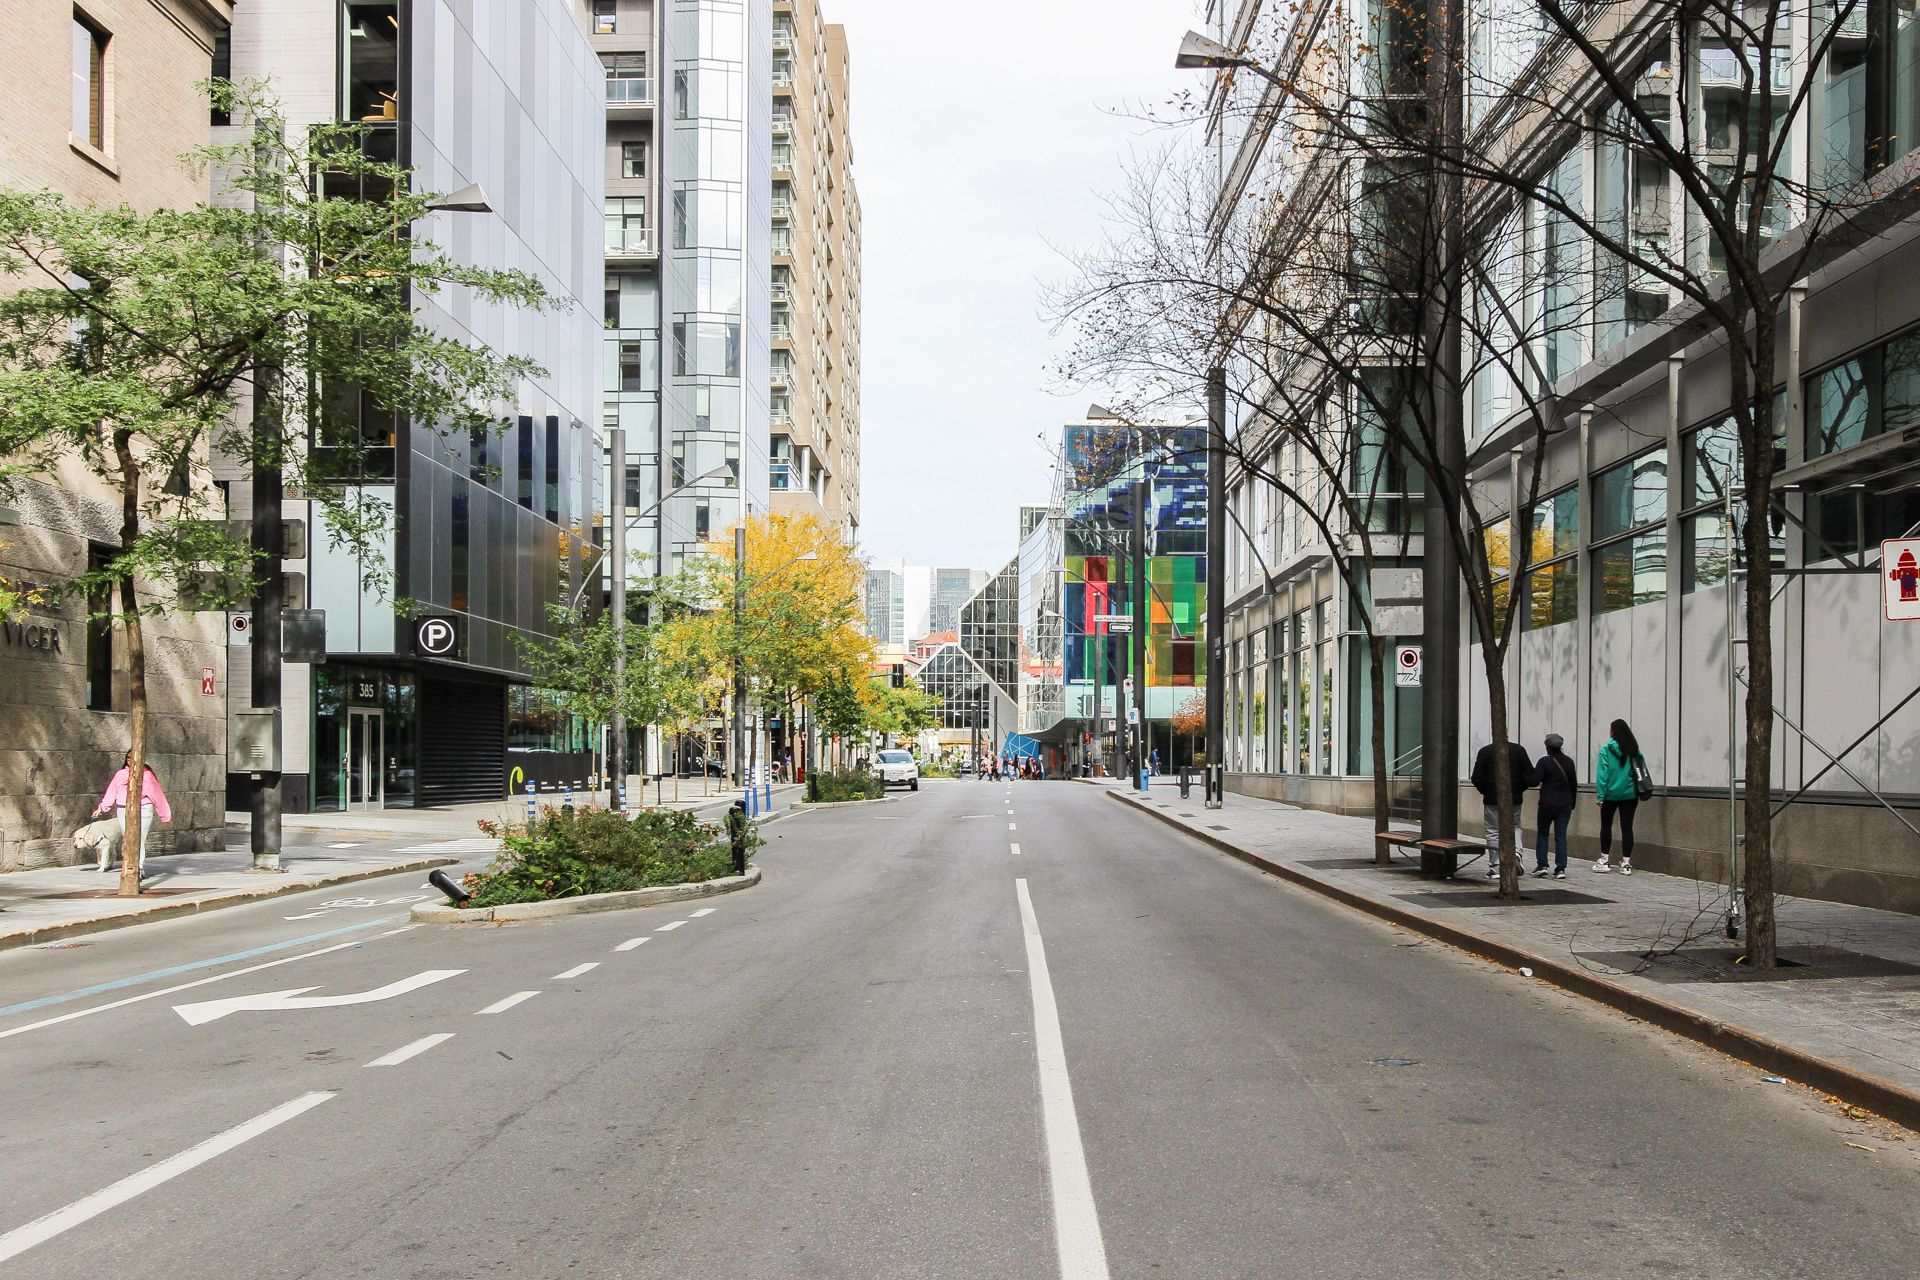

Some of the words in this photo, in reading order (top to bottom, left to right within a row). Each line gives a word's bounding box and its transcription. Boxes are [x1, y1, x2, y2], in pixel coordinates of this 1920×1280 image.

[4, 620, 62, 655] VIGER
[428, 624, 446, 648] P
[359, 683, 374, 698] 385
